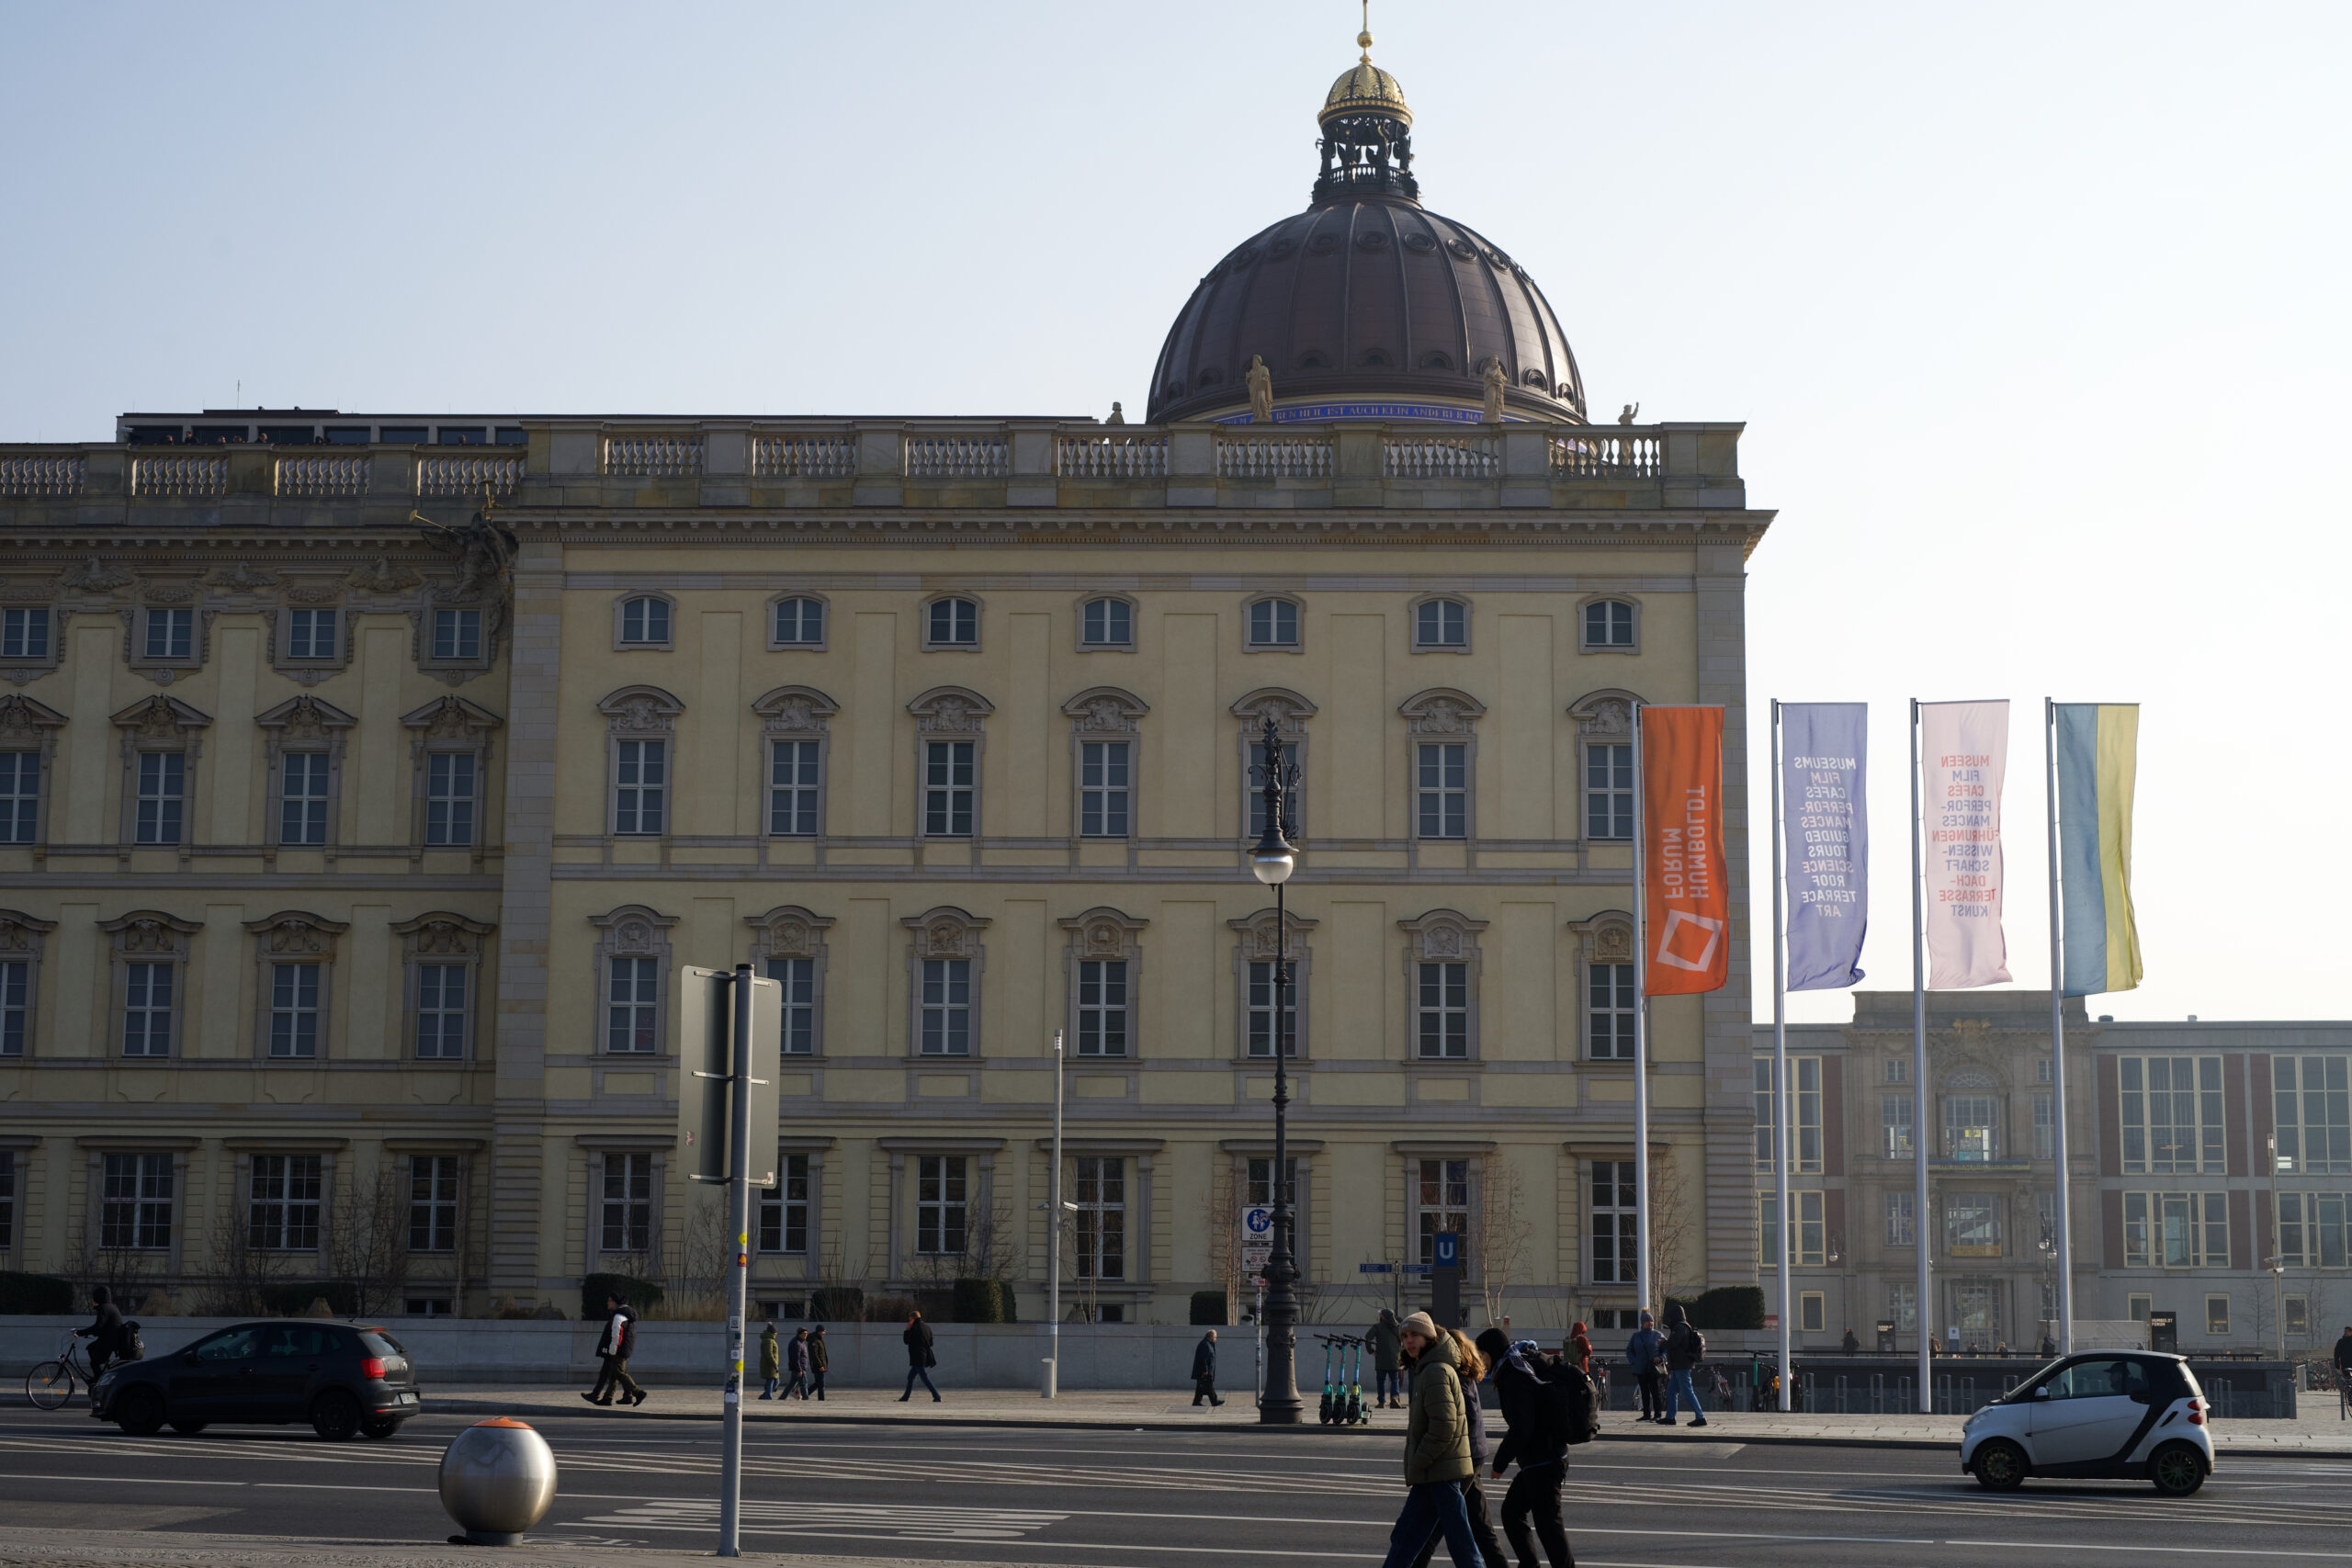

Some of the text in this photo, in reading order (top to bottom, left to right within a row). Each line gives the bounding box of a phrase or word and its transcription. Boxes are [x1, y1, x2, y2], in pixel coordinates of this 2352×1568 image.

[1349, 406, 1378, 415] AUCH
[1382, 406, 1409, 415] KEIN
[1439, 1241, 1453, 1259] U
